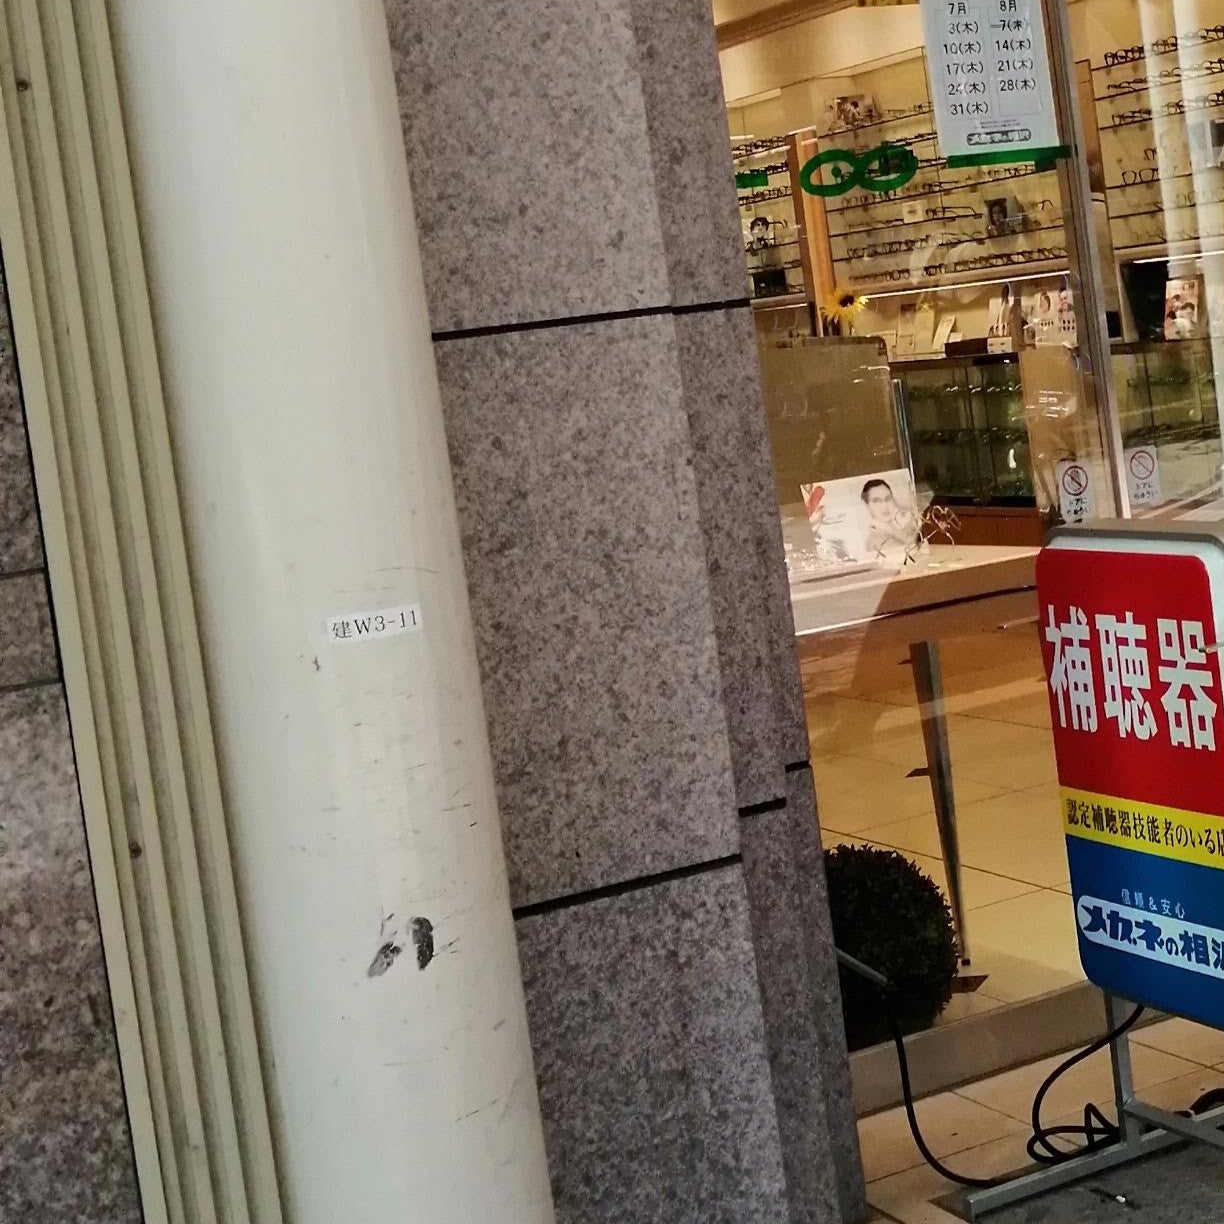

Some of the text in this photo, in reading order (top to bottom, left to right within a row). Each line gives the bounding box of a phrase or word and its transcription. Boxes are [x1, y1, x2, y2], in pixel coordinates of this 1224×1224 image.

[948, 0, 1017, 15] 7月 8月
[944, 38, 1031, 55] 10(木) 14(木)
[945, 59, 1033, 75] 17(木) 21(木)
[999, 79, 1036, 92] 28(木)
[950, 101, 989, 116] 31(木)
[332, 609, 417, 639] 建W3-11
[1045, 604, 1218, 752] 補聴器
